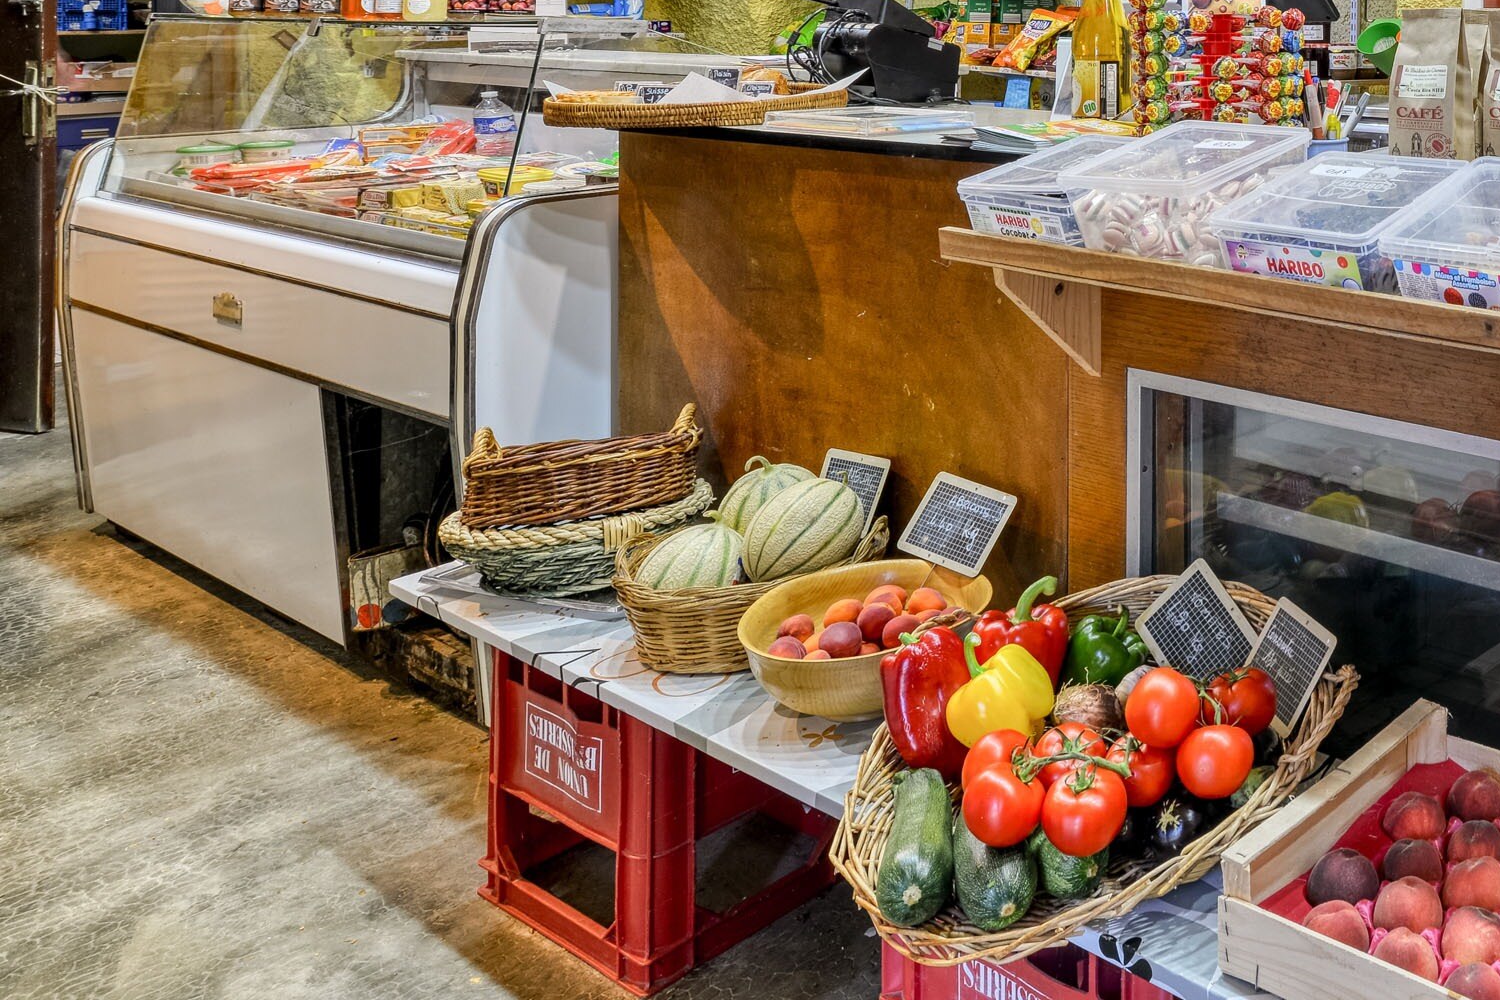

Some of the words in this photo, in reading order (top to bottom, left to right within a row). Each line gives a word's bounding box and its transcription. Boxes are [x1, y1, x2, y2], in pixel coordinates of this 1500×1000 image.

[1083, 103, 1097, 113] BIO
[1396, 106, 1445, 121] CAFÉ
[994, 213, 1030, 229] HARIBO
[1266, 257, 1324, 278] HARIBO
[1434, 270, 1455, 281] Mûres
[1456, 272, 1463, 281] et
[1463, 273, 1496, 288] Framboises
[1452, 279, 1480, 290] Assorties
[534, 744, 551, 774] DE
[557, 756, 590, 799] UNION
